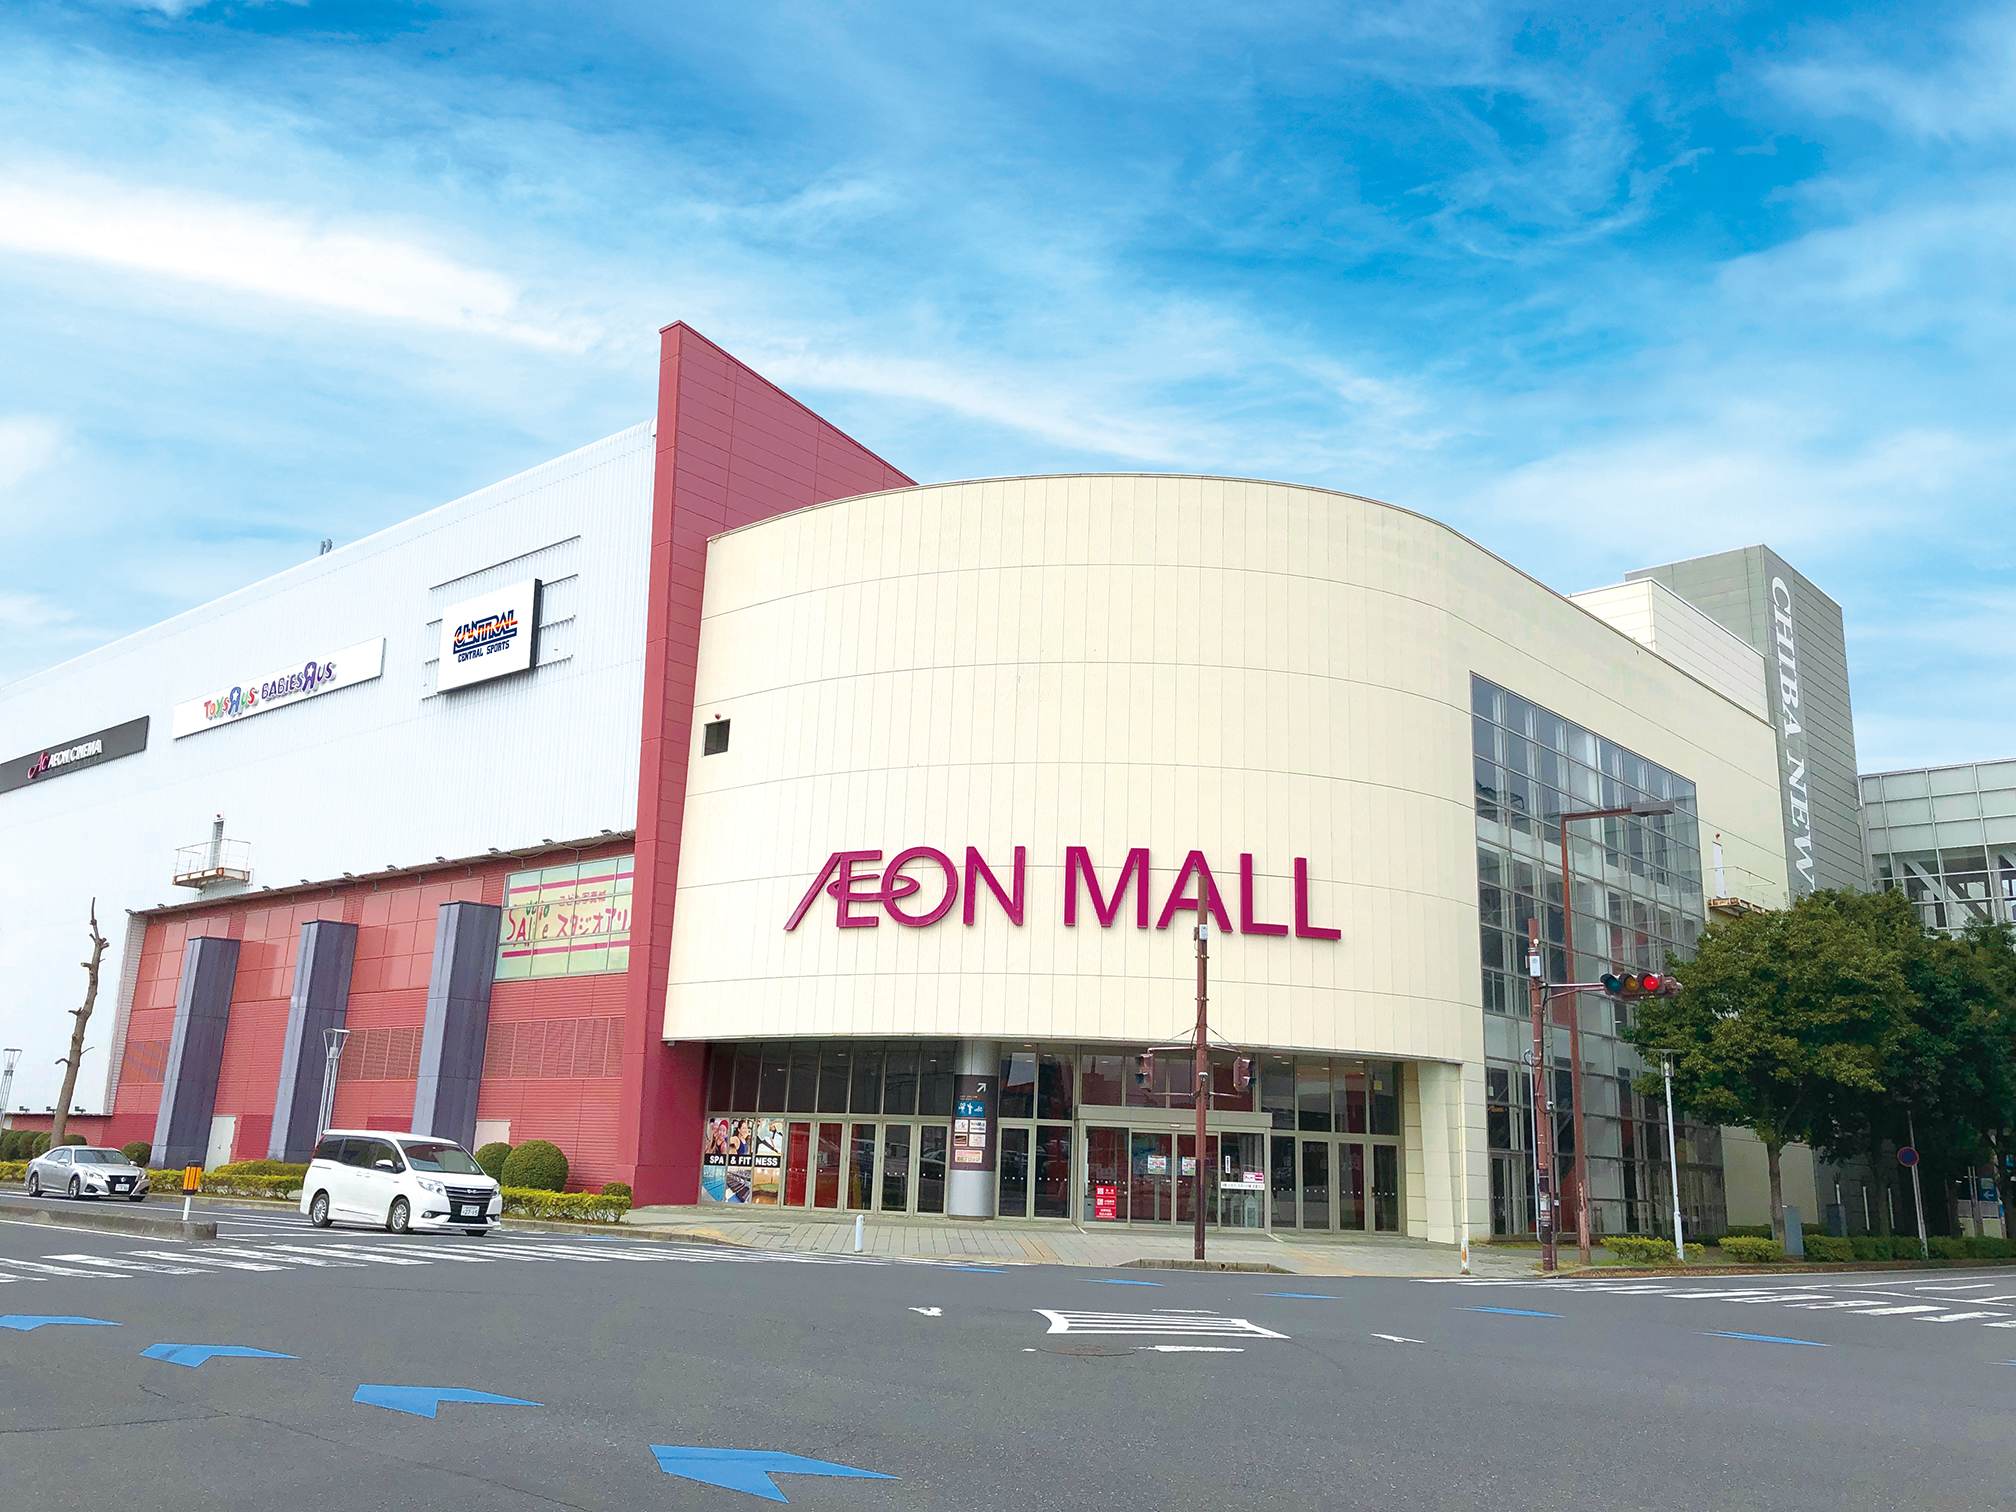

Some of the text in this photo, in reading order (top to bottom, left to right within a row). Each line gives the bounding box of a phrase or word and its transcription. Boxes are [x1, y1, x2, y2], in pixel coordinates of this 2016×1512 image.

[458, 640, 510, 663] CENTRAL SPORTS
[1772, 576, 1816, 892] CHIBA NEW
[1064, 846, 1342, 940] MALL
[556, 908, 630, 938] スタジオアリ
[709, 1155, 724, 1165] SPA
[730, 1156, 736, 1165] &
